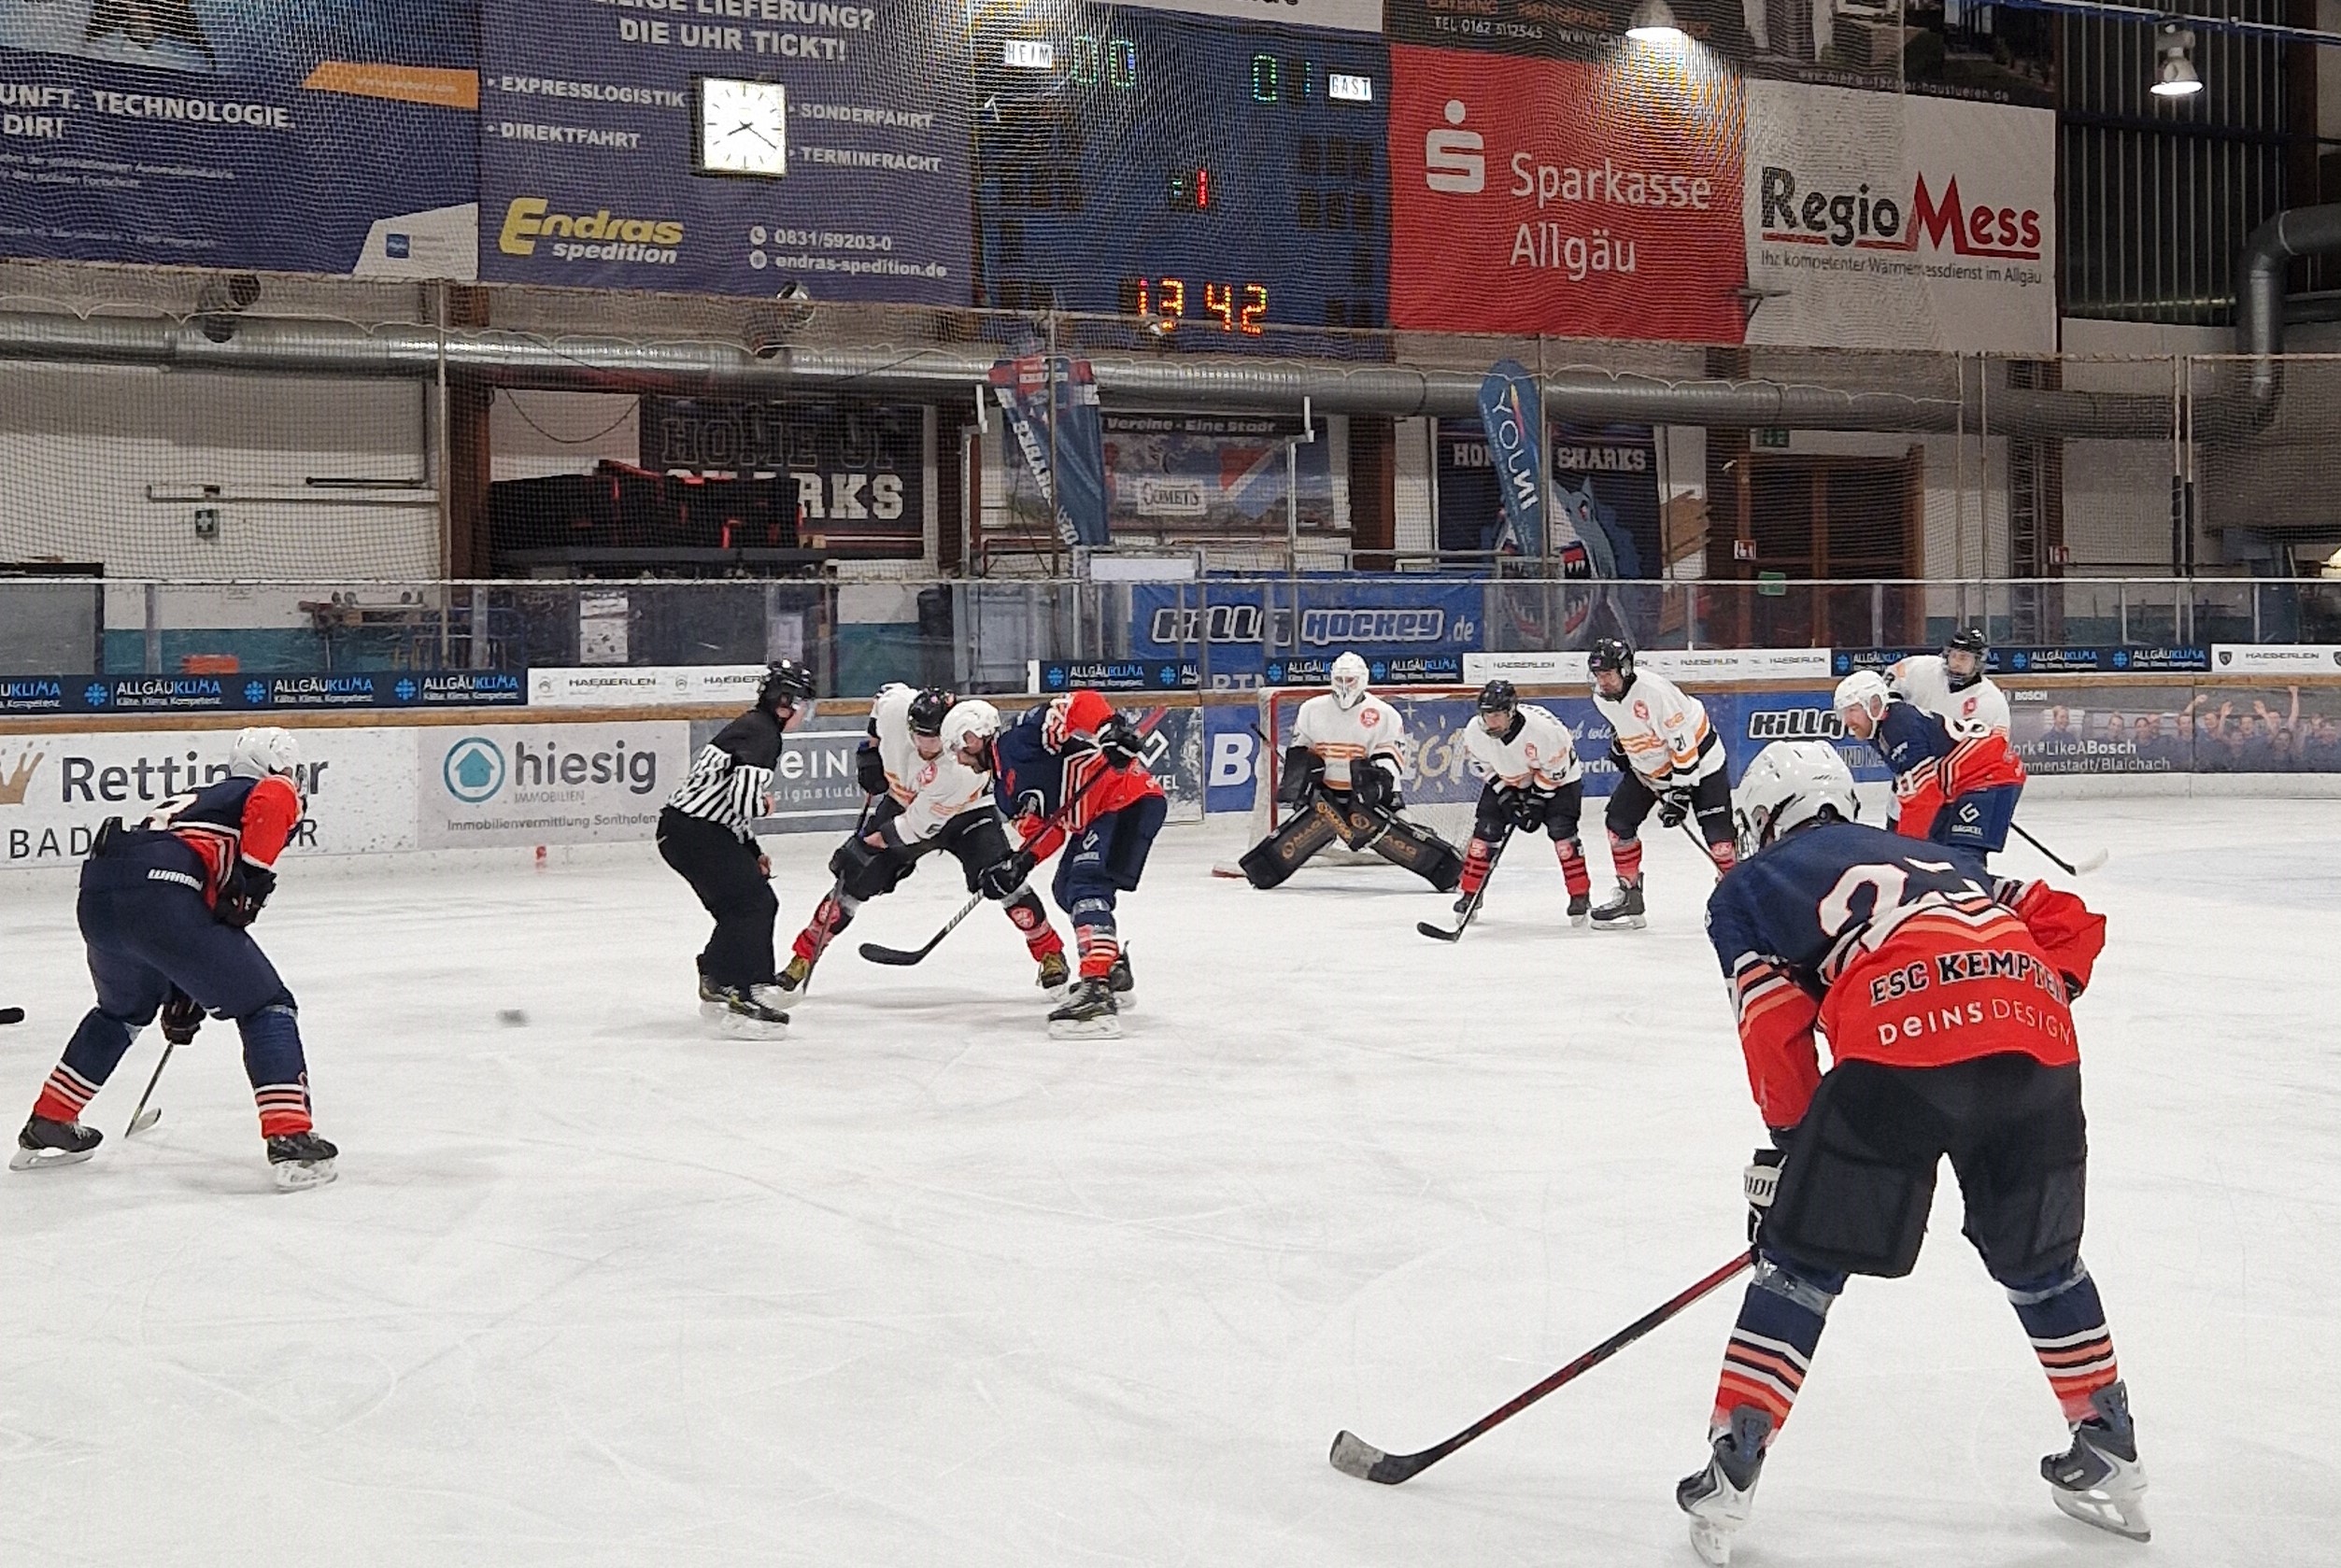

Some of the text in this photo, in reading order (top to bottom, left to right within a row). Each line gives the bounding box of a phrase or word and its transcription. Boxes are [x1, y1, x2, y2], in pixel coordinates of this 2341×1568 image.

[698, 0, 875, 31] LIEFERUNG?
[620, 18, 847, 62] DIE UHR TICKT!
[1006, 43, 1053, 67] HEIM
[1330, 75, 1372, 101] GAST
[501, 76, 687, 108] EXPRESSLOGISTIK
[93, 91, 296, 129] TECHNOLOGIE.
[801, 102, 934, 130] SONDERFAHRT
[3, 114, 64, 139] DIR!
[501, 121, 641, 149] DIREKTFAHRT
[802, 146, 943, 173] TERMINFRACHT
[1511, 152, 1712, 210] Sparkasse
[499, 196, 685, 256] Endras
[774, 228, 892, 251] 0831/59203-0
[552, 240, 678, 265] spedition
[1509, 221, 1637, 282] Allgäu
[775, 253, 948, 278] endras-spedition.de
[1986, 267, 2001, 280] im
[1557, 446, 1647, 471] SHARKS
[0, 681, 62, 697] UKLIMA
[702, 675, 767, 685] HAEBER
[2014, 690, 2048, 701] BOSCH
[2010, 740, 2137, 756] ork#LikeABosch
[515, 740, 656, 795] hiesig
[514, 789, 585, 804] IMMOBILIEN
[447, 812, 658, 832] Immobilienvermittlung Sonthofen
[1869, 963, 1930, 1007] ESC
[1992, 997, 2072, 1045] DESIGN
